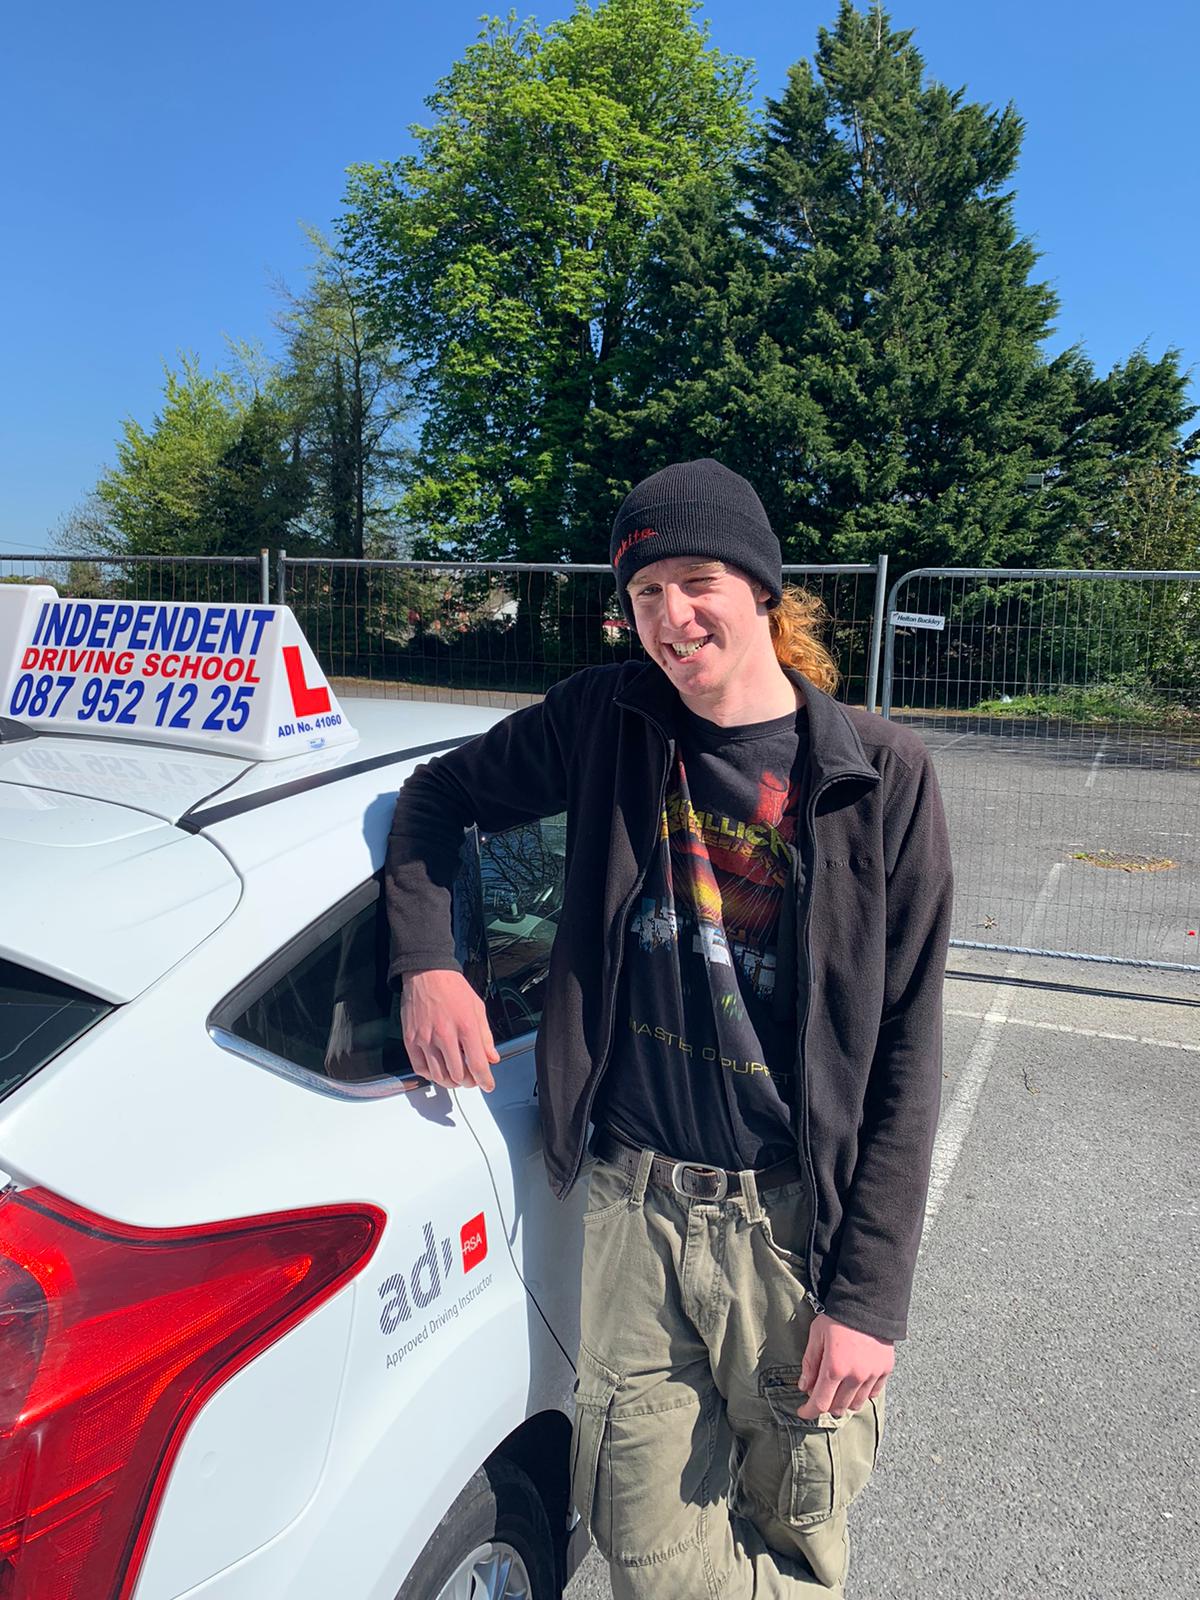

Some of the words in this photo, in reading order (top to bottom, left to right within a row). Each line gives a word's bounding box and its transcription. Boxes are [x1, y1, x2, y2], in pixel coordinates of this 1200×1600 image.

[32, 603, 275, 655] INDEPENDENT
[917, 617, 941, 626] Buckley
[21, 648, 135, 674] DRIVING
[142, 653, 261, 683] SCHOOL
[282, 645, 332, 718] L
[10, 673, 76, 717] 087
[77, 678, 146, 724] 952
[155, 682, 198, 728] 12
[201, 686, 255, 732] 25
[278, 724, 295, 737] ADI
[297, 721, 313, 733] No.
[315, 714, 342, 729] 41060
[462, 1233, 482, 1256] RSA
[386, 1325, 429, 1369] Approved
[429, 1303, 459, 1335] Driving
[458, 1274, 494, 1308] Instructor
